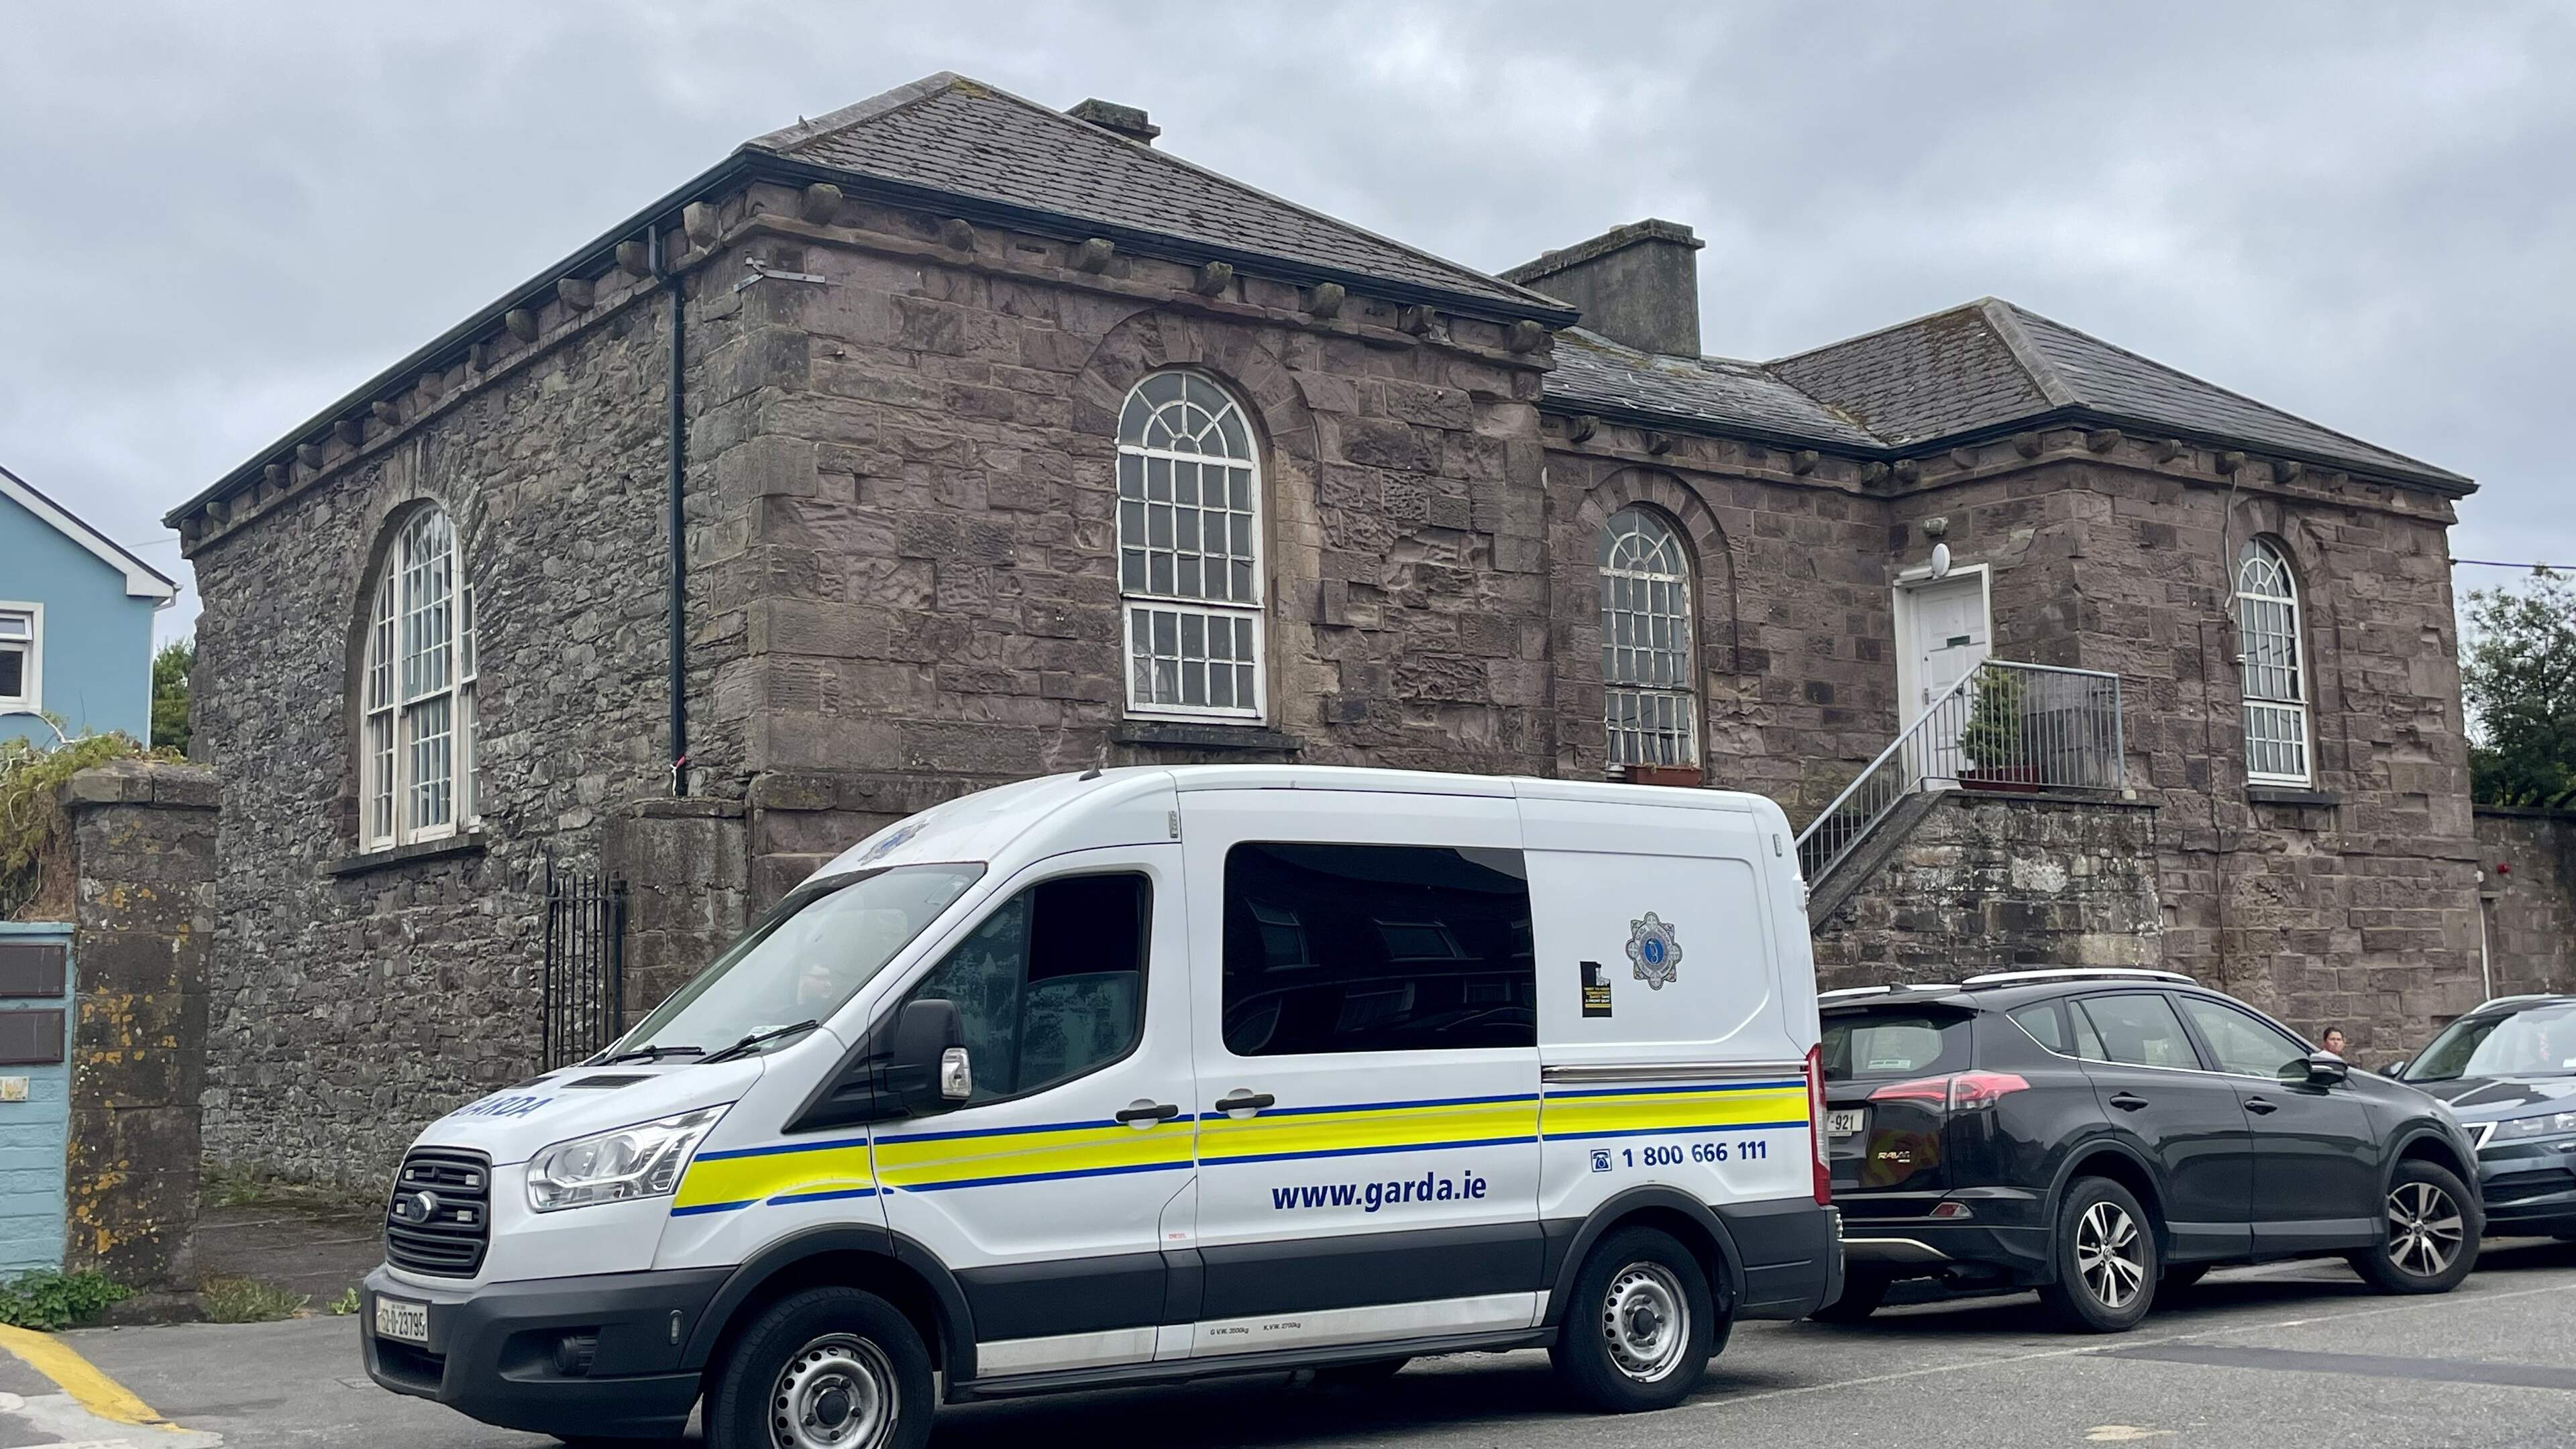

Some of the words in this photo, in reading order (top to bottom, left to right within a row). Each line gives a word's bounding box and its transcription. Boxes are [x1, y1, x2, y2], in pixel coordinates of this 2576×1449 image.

[450, 1096, 554, 1118] GARDA
[1622, 1148, 1633, 1167] 1
[1644, 1145, 1684, 1166] 800
[1691, 1142, 1728, 1163] 666
[1737, 1140, 1766, 1160] 111
[1271, 1169, 1487, 1213] www.garda.ie
